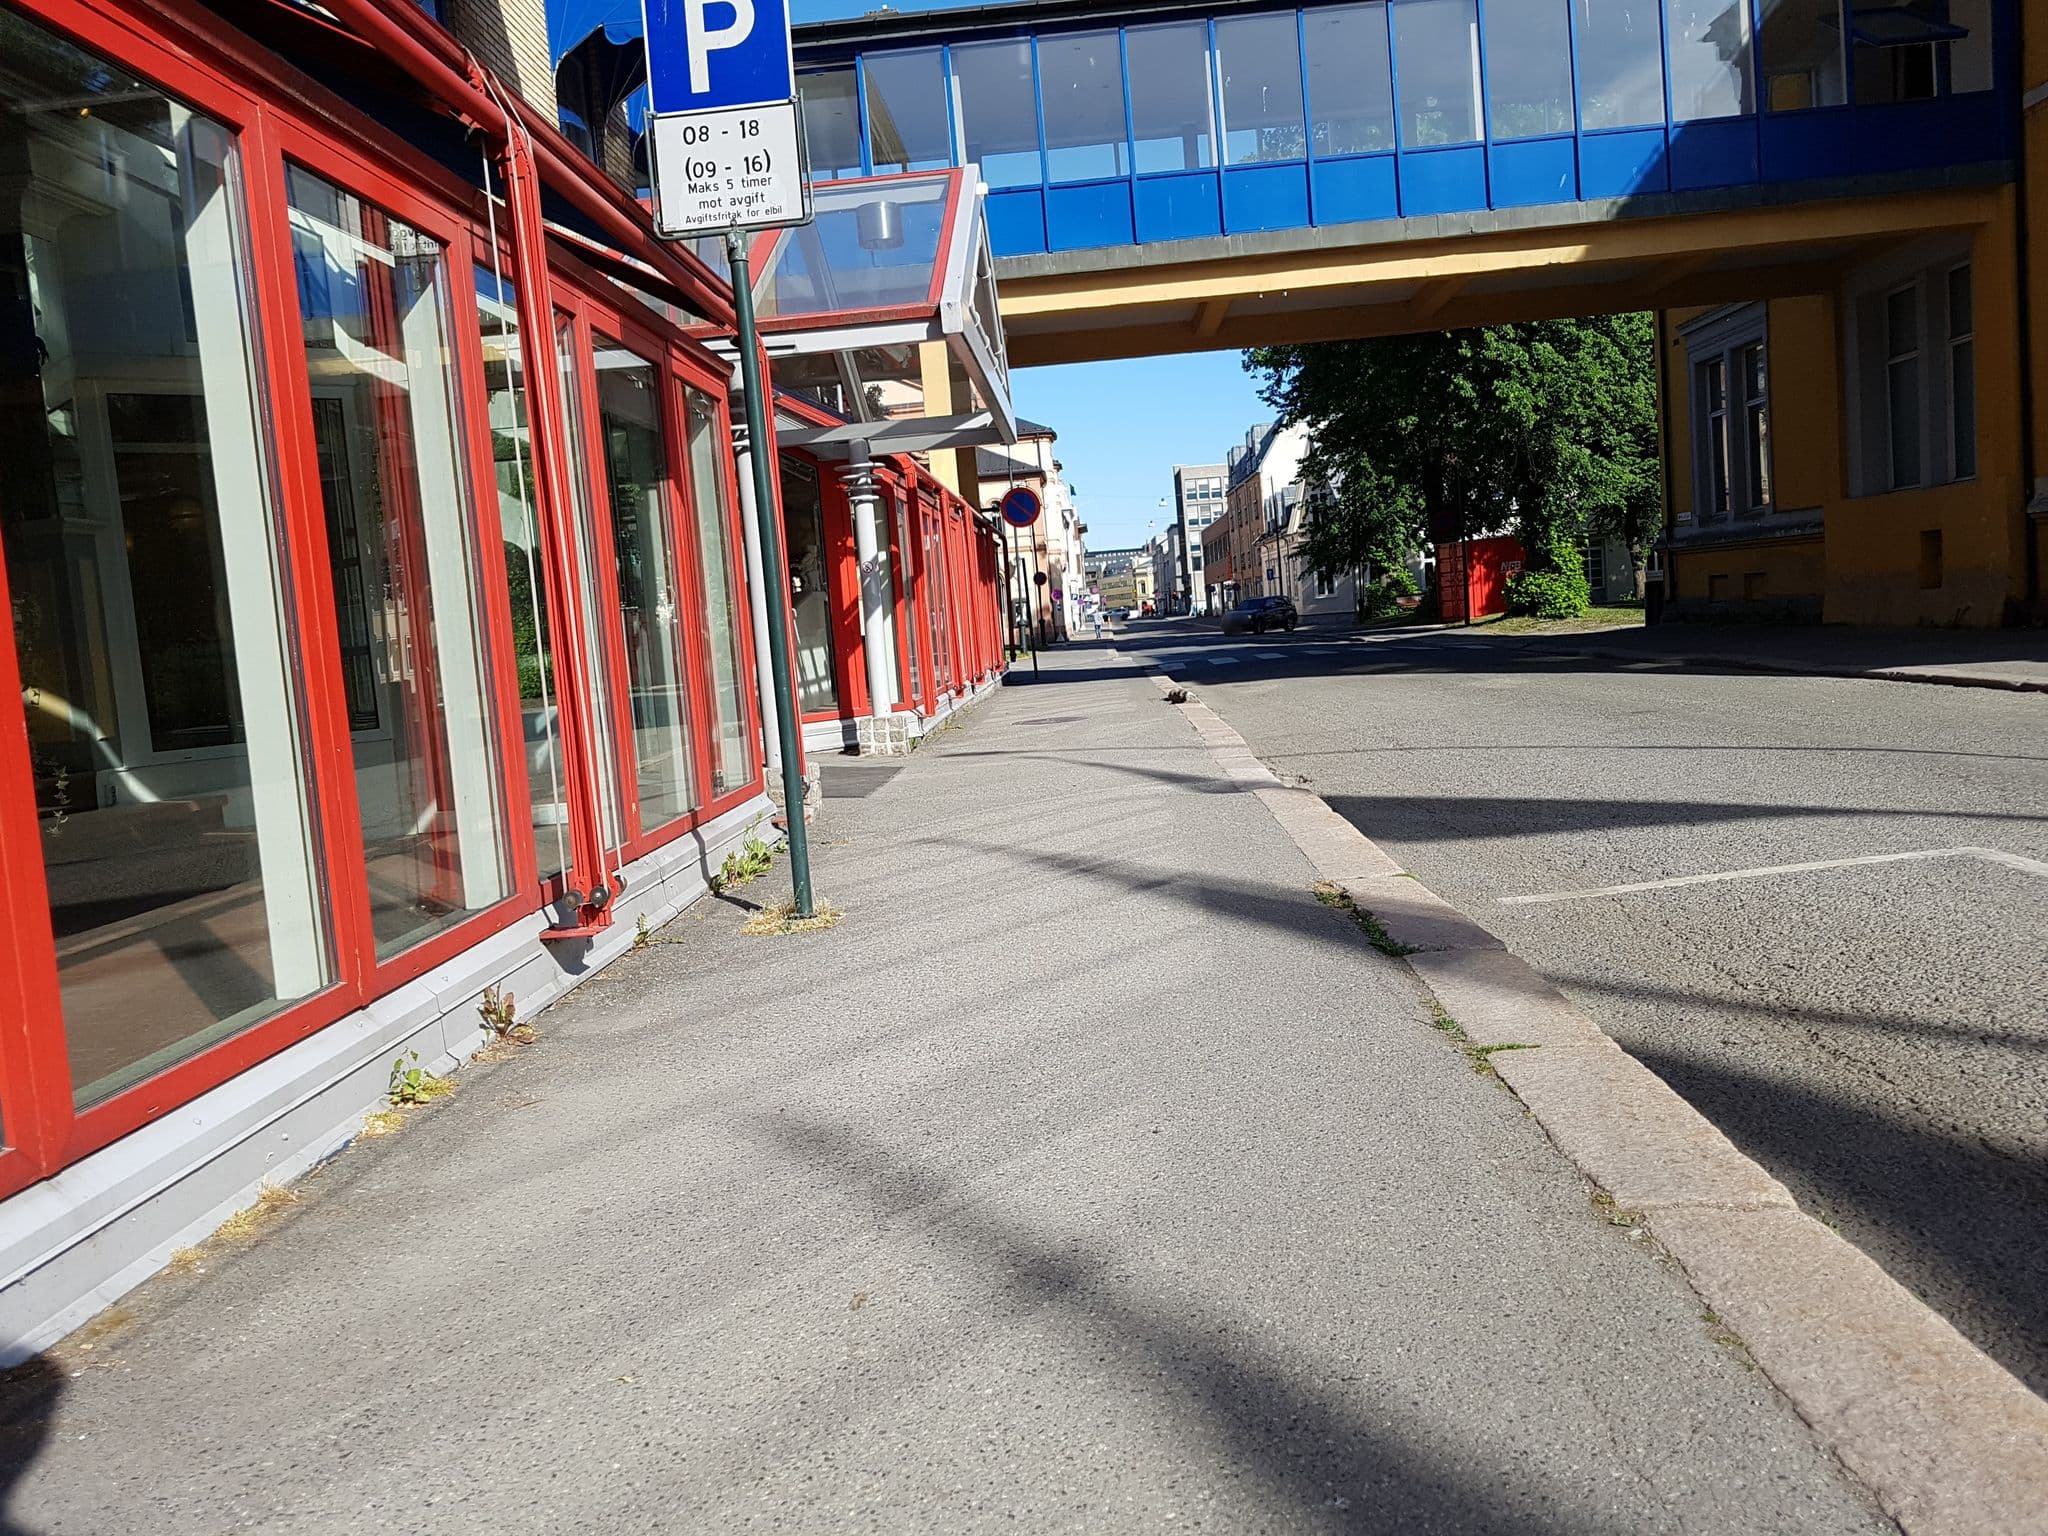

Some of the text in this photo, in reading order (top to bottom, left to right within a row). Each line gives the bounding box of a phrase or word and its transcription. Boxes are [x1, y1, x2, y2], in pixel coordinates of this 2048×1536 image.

[684, 0, 755, 94] P
[683, 126, 709, 145] 08
[739, 120, 760, 138] 18
[685, 157, 716, 181] (09
[743, 149, 771, 175] 16)
[688, 176, 772, 194] Maks 5 timer
[698, 192, 765, 209] mot avgift
[685, 206, 783, 225] Avgiftsfritak for elbil
